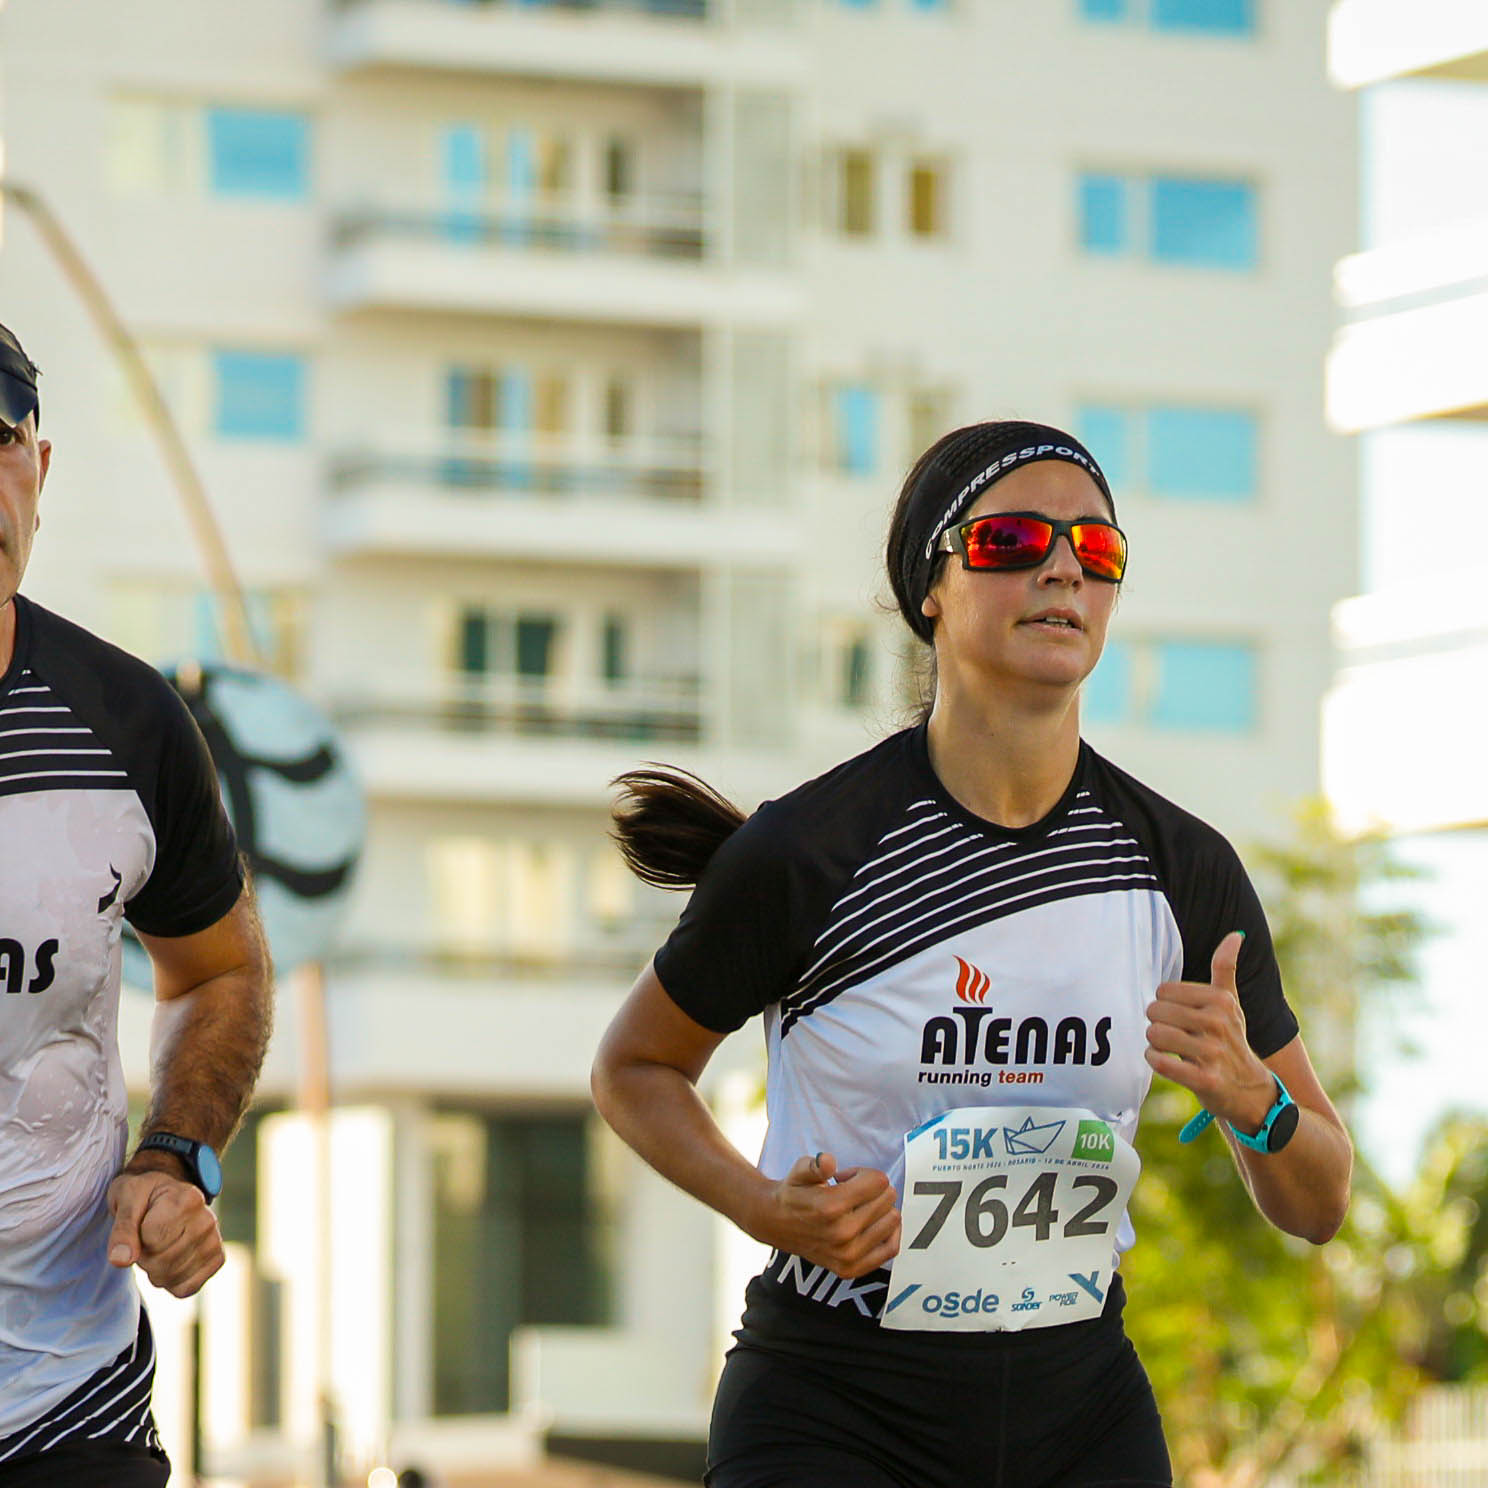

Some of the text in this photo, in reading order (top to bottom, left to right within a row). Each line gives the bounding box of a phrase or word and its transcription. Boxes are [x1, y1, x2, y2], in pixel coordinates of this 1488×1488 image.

[920, 1006, 1112, 1066] ATENAS
[918, 1069, 1044, 1087] running team
[933, 1128, 998, 1160] 15K
[1080, 1133, 1111, 1150] 10K
[932, 1164, 961, 1172] PUERTO
[908, 1173, 1118, 1250] 7642
[777, 1254, 893, 1320] NIK
[922, 1288, 1000, 1318] osde
